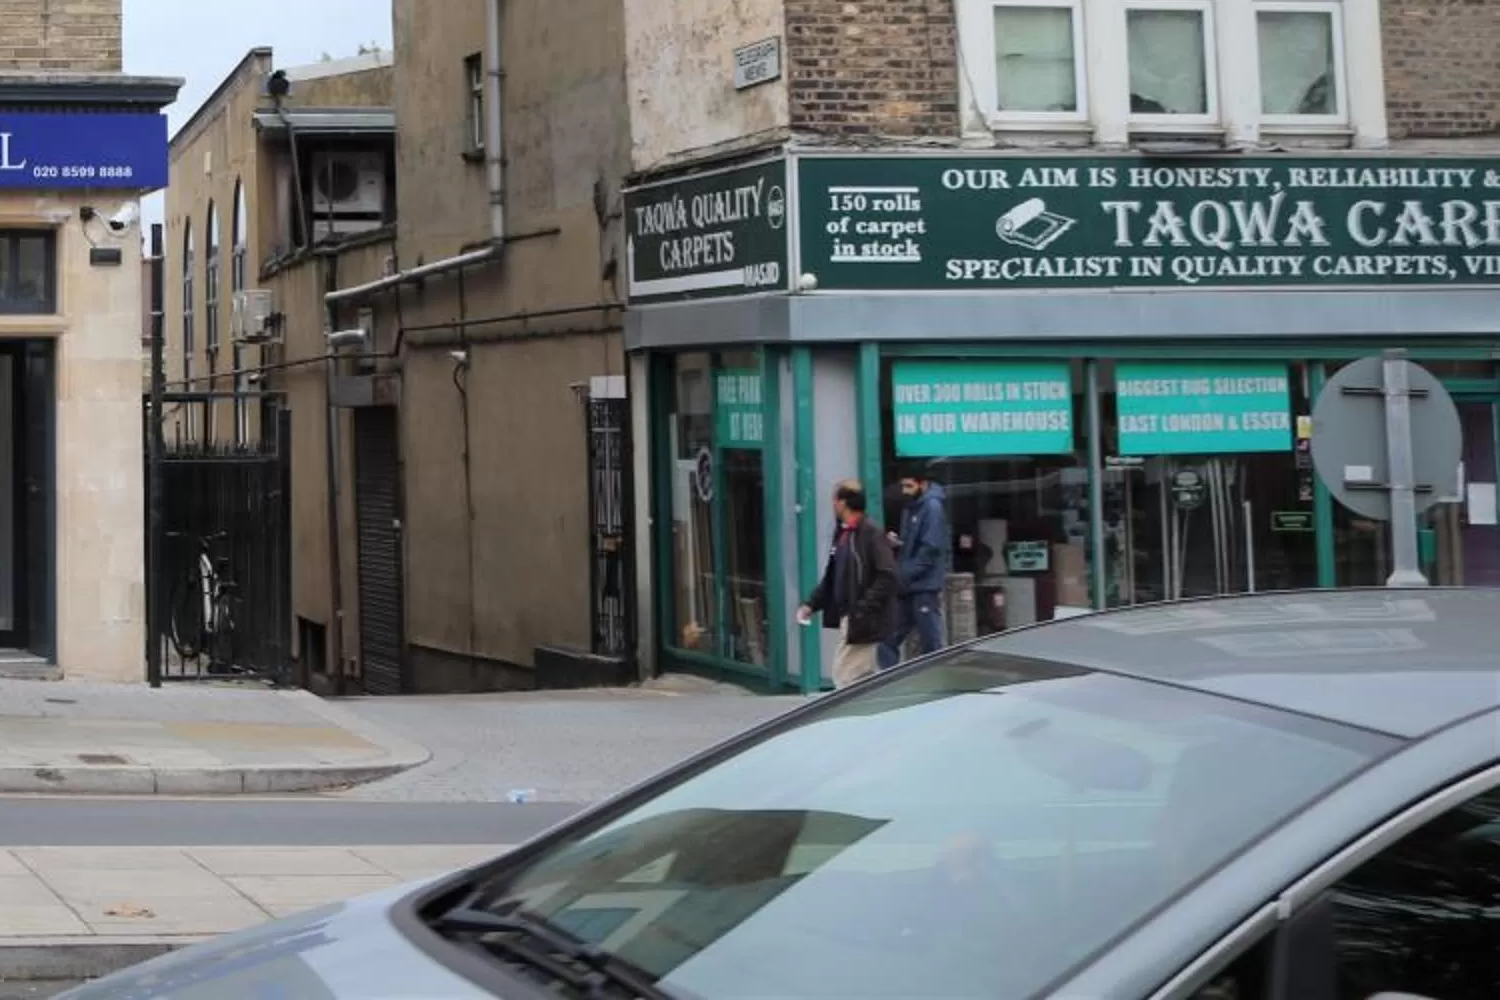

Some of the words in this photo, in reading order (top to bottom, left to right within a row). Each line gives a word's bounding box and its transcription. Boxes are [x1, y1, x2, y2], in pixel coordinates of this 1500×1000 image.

[33, 166, 58, 178] 020
[61, 166, 95, 178] 8599
[99, 166, 133, 178] 8888
[942, 168, 1011, 190] OUR
[1018, 166, 1079, 188] AIM
[1088, 166, 1117, 188] IS
[1128, 166, 1282, 193] HONESTY,
[1288, 167, 1476, 188] RELIABILITY
[691, 176, 764, 229] QUALITY
[829, 194, 867, 212] 150
[872, 194, 921, 212] rolls
[825, 216, 852, 235] of
[855, 217, 926, 239] carpet
[659, 230, 735, 272] CARPETS
[832, 238, 856, 257] in
[861, 238, 921, 257] stock
[945, 256, 1127, 281] SPECIALIST
[1131, 255, 1163, 277] IN
[1171, 255, 1305, 283] QUALITY
[1312, 254, 1457, 280] CARPETS,
[1006, 381, 1020, 401] IN
[1023, 380, 1067, 400] STOCK
[898, 414, 917, 434] IN
[920, 413, 957, 434] OUR
[961, 410, 1069, 433] WAREHOUSE
